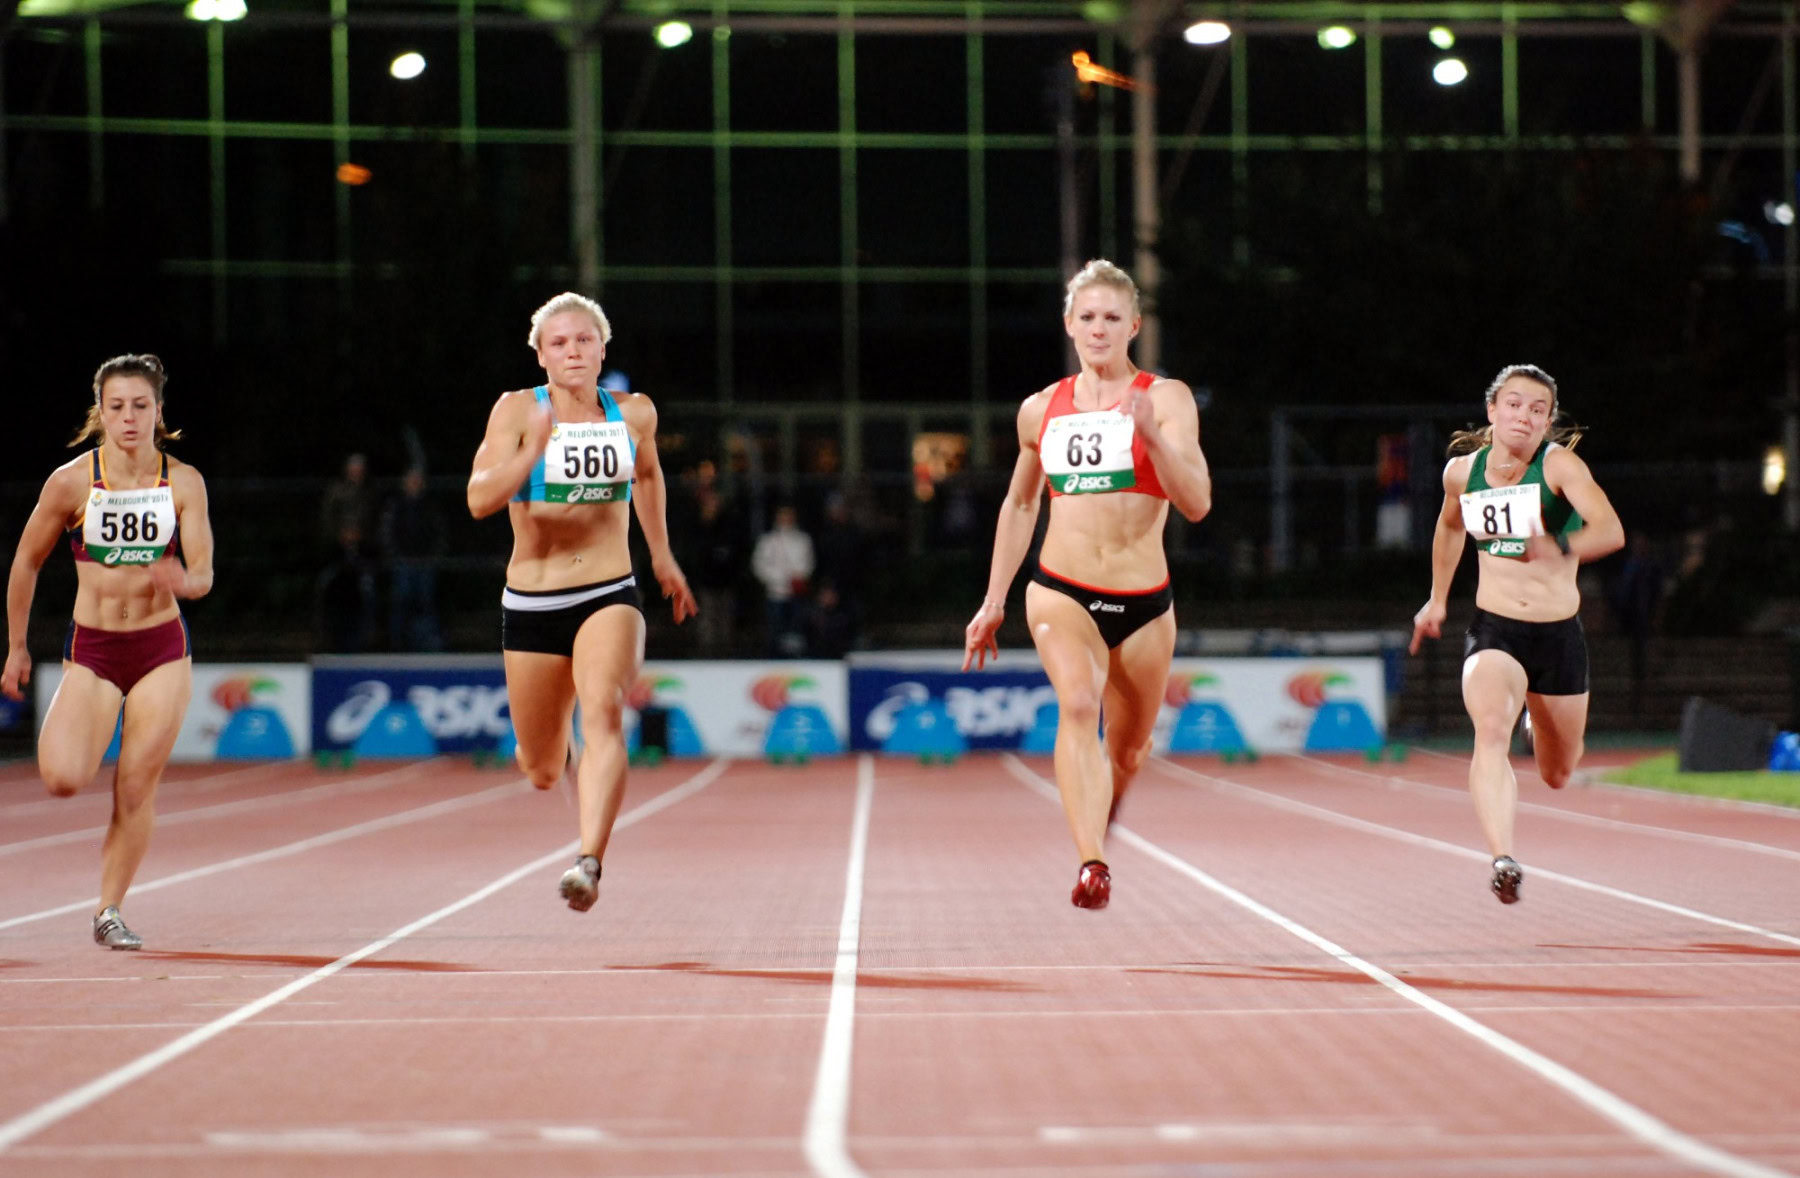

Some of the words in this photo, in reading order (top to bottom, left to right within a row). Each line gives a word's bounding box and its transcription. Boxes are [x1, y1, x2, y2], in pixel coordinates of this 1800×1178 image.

[563, 444, 618, 479] 560
[1066, 432, 1102, 467] 63
[101, 511, 159, 542] 586
[1483, 502, 1512, 535] 81
